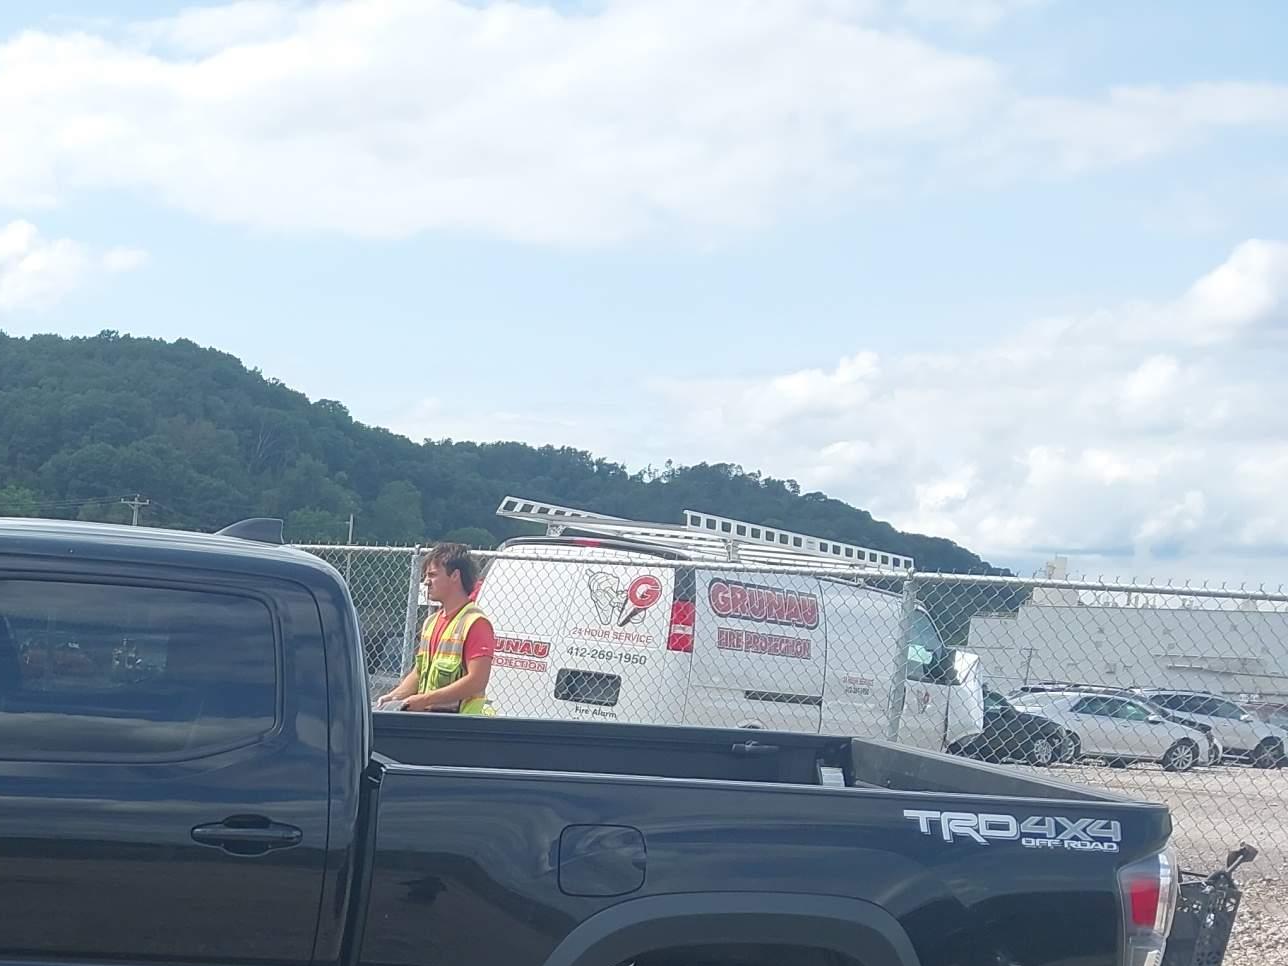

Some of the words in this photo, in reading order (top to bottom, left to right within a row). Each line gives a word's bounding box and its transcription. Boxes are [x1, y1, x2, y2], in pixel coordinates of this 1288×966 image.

[708, 578, 819, 630] GRUNAU
[572, 627, 583, 635] 24
[584, 628, 610, 639] HOUR
[612, 631, 653, 643] SERVICE
[717, 627, 744, 651] FIRE
[744, 630, 811, 660] PROTECTION
[493, 636, 551, 658] UNAU
[566, 646, 647, 665] 412-269-1950
[492, 656, 547, 672] OTECTION
[575, 704, 590, 714] Fire
[592, 706, 617, 718] Alarm
[903, 809, 1020, 845] TRD
[1021, 838, 1063, 849] OFF
[1063, 840, 1120, 853] ROAD
